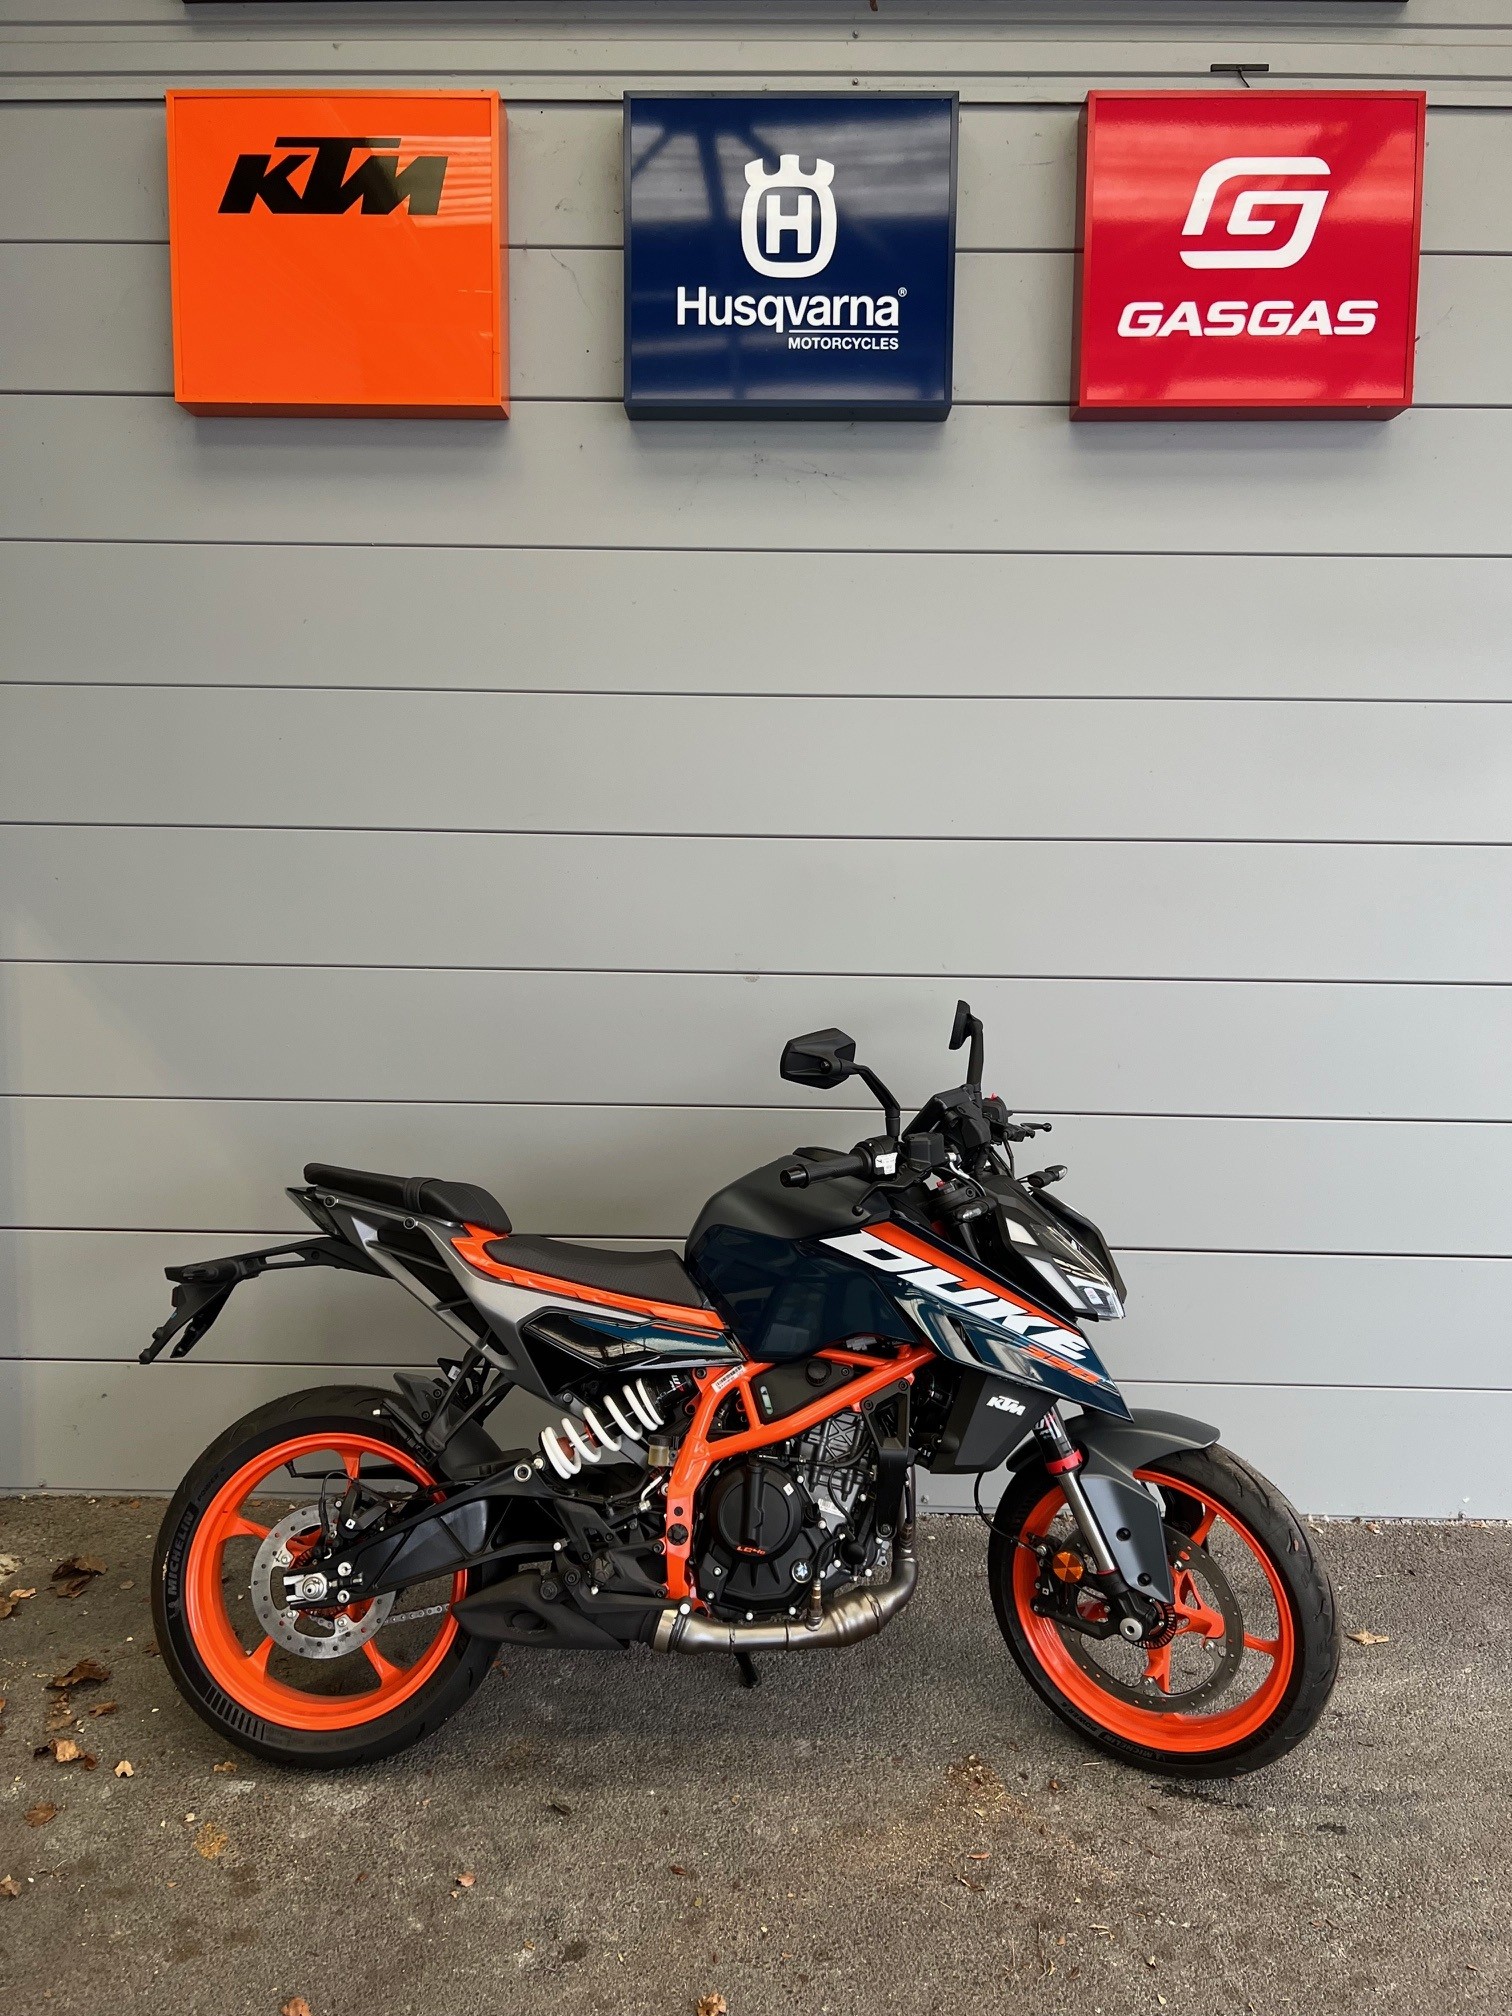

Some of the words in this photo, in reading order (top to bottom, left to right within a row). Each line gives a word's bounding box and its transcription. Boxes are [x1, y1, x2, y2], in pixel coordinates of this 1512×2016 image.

[218, 137, 448, 215] KTM
[766, 195, 812, 254] H
[788, 337, 899, 350] MOTORCYCLES
[1117, 300, 1379, 337] GASGAS
[819, 1233, 1091, 1361] DUKE
[986, 1395, 1026, 1417] KTM
[167, 1509, 196, 1597] MICHELIN
